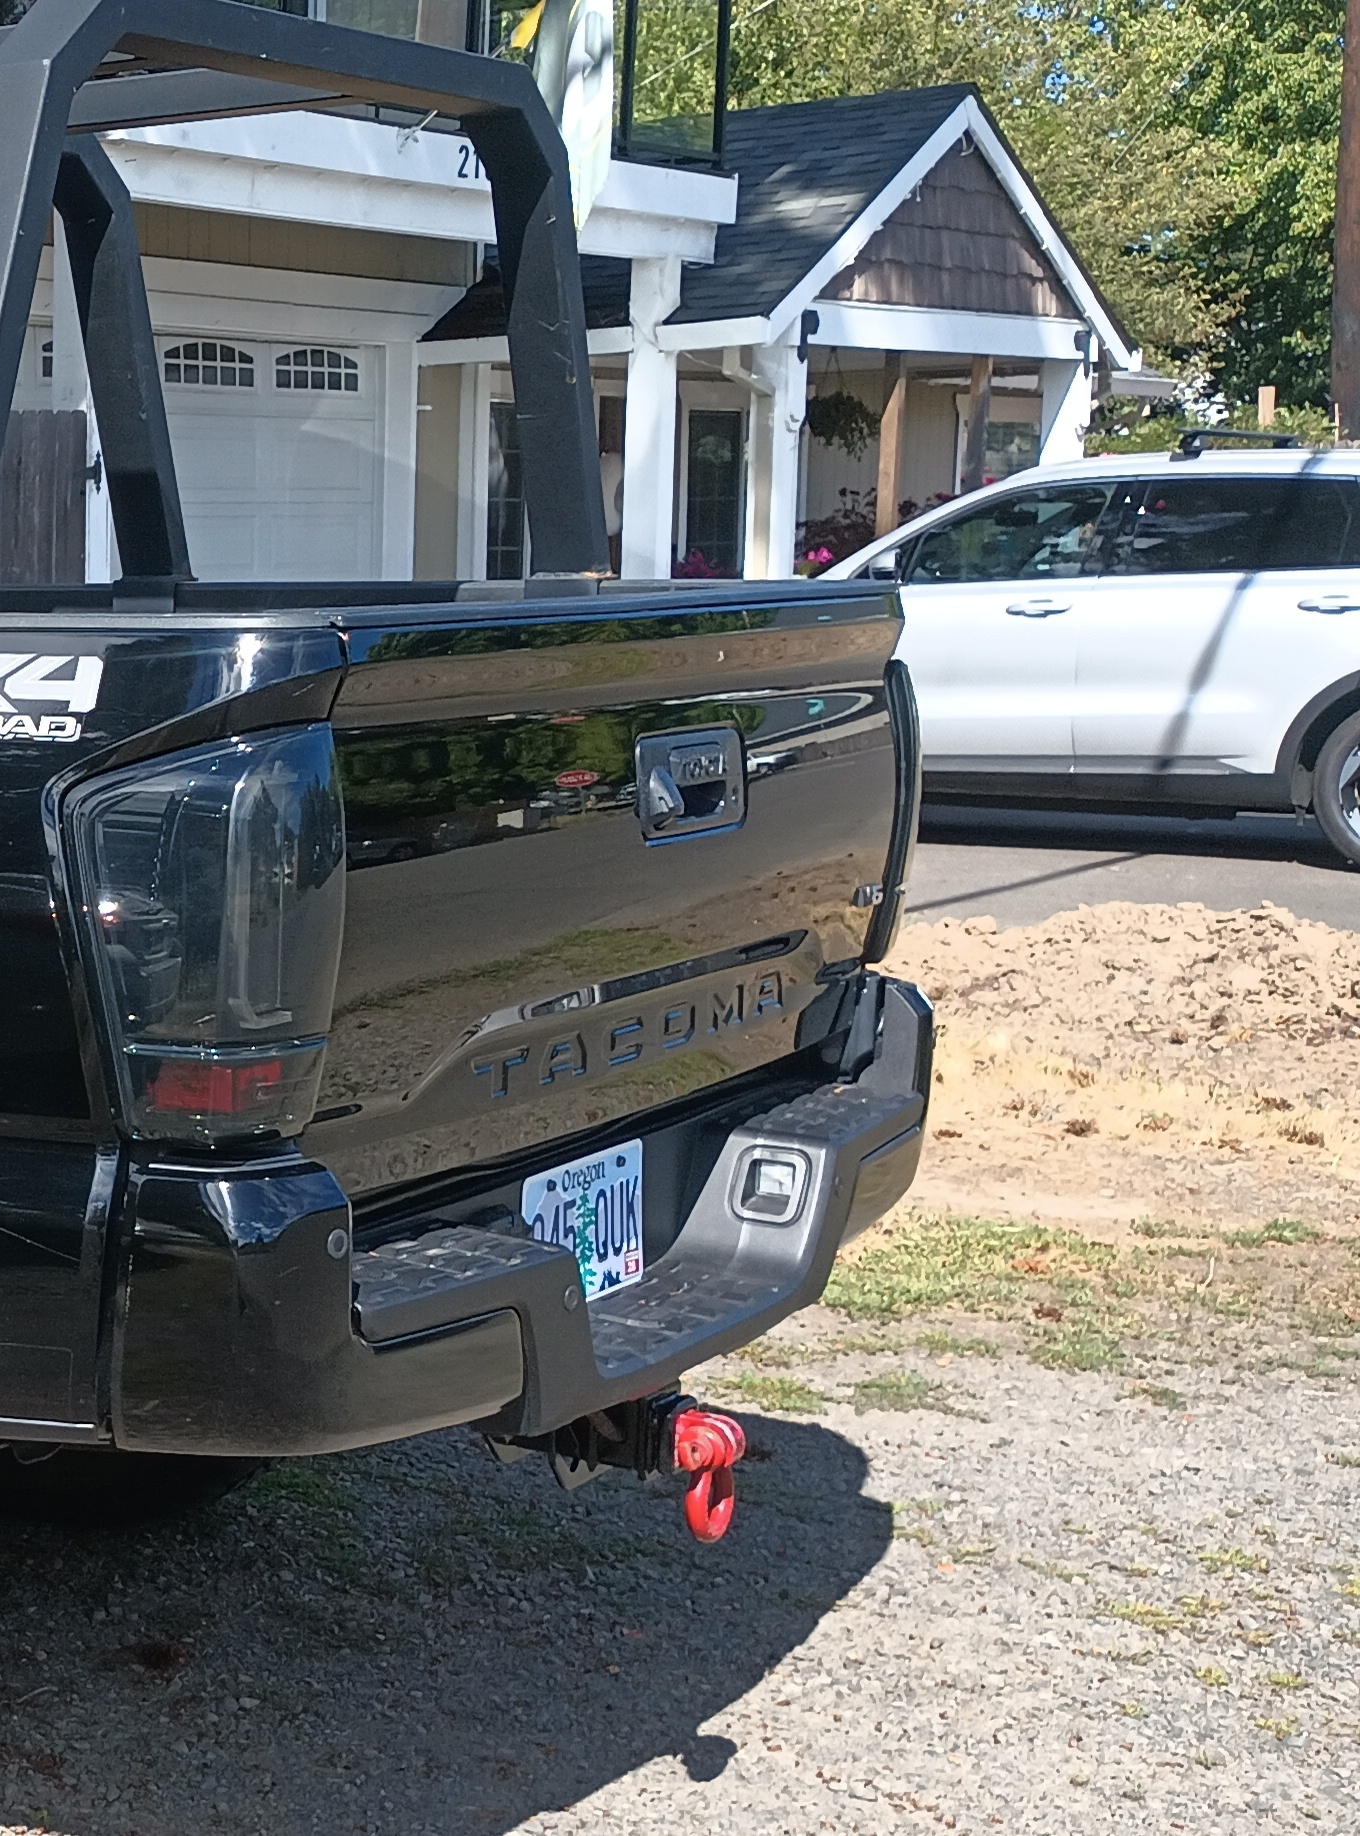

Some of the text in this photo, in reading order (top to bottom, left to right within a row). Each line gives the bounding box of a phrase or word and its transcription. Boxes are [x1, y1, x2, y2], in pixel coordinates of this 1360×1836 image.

[471, 970, 784, 1099] TACOMA
[562, 1161, 606, 1191] Oregon
[595, 1175, 639, 1263] QUK
